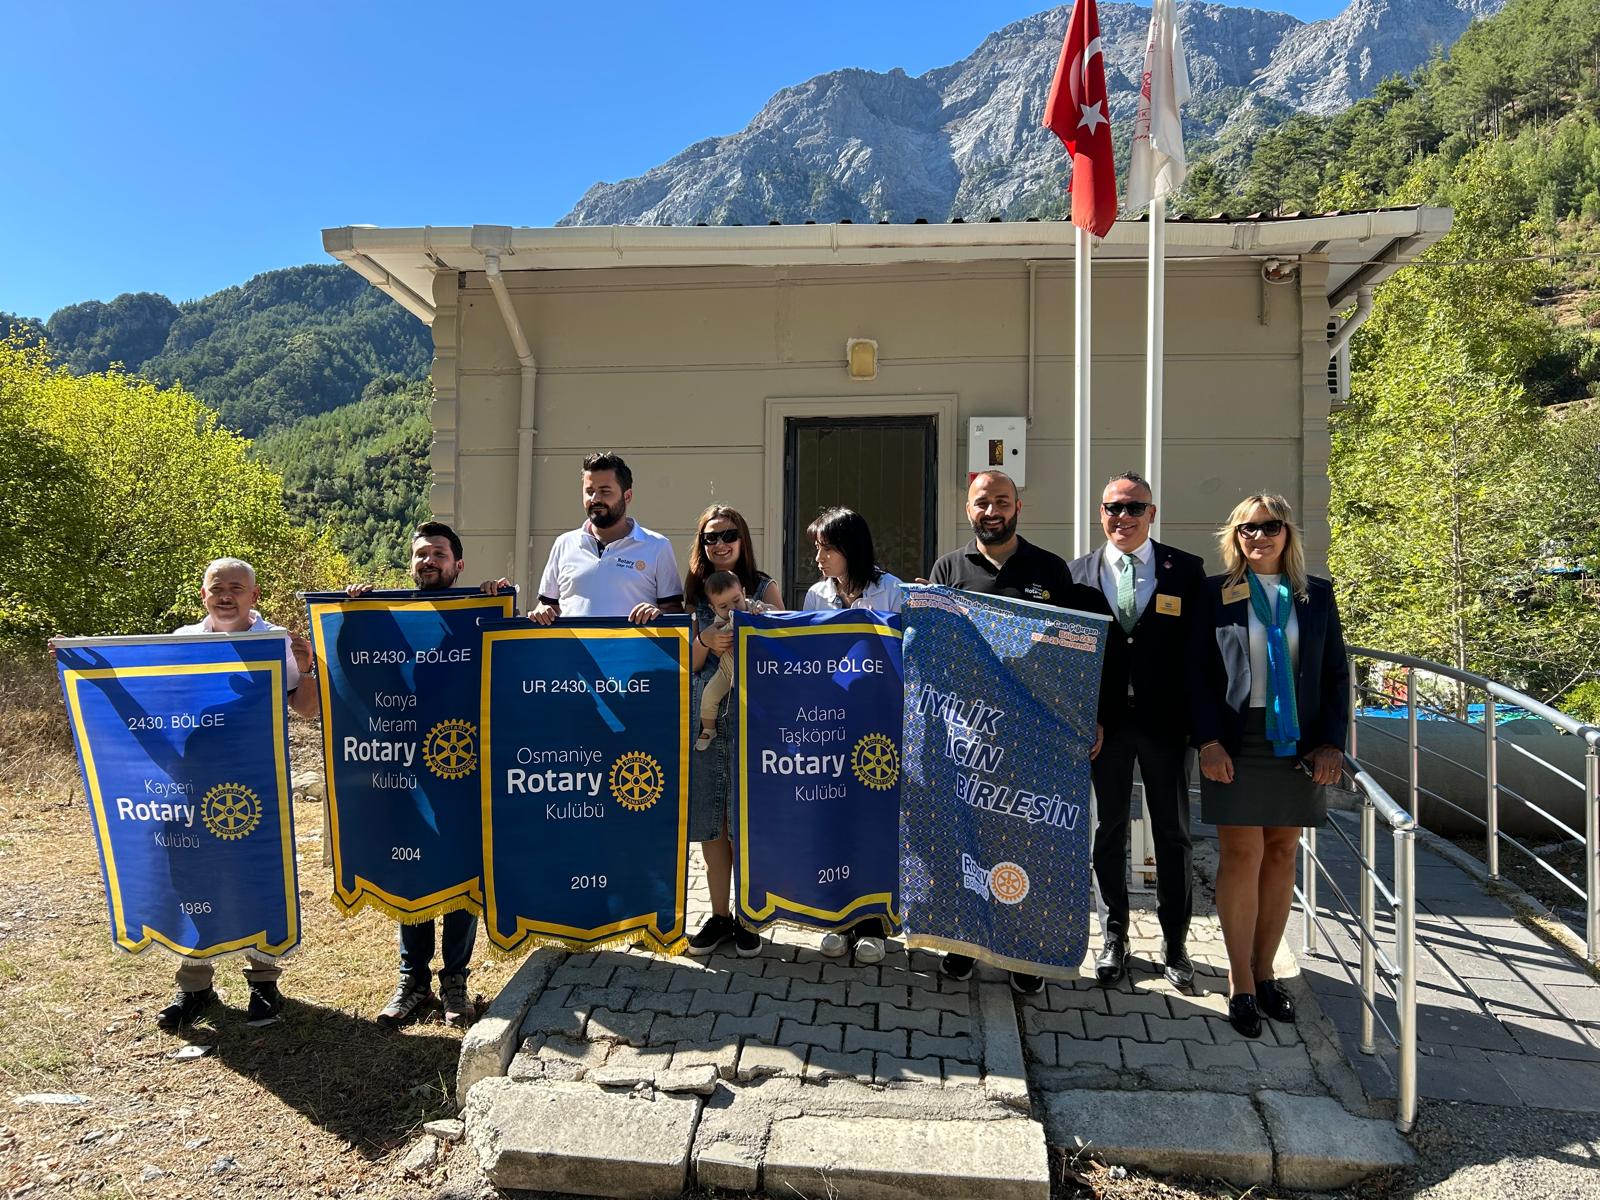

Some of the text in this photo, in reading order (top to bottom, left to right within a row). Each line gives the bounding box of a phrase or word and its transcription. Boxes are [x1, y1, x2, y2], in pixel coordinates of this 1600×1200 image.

[983, 604, 1014, 617] Camargo
[1054, 620, 1068, 630] Can
[1059, 630, 1079, 641] Bölge
[351, 648, 471, 665] UR 2430. BÖLGE
[757, 657, 884, 675] UR 2430 BÖLGE
[522, 677, 650, 694] UR 2430. BÖLGE
[375, 691, 417, 711] Konya
[917, 684, 1004, 735] İYİLİK
[128, 712, 225, 731] 2430. BÖLGE
[796, 706, 846, 722] Adana
[369, 717, 417, 732] Meram
[779, 727, 846, 748] Taşköprü
[343, 736, 417, 767] Rotary
[517, 746, 602, 766] Osmaniye
[946, 728, 1004, 773] İÇİN
[762, 750, 845, 778] Rotary
[144, 779, 194, 799] Kayseri
[372, 772, 417, 789] Kulübü
[507, 769, 603, 796] Rotary
[795, 784, 847, 801] Kulübü
[956, 773, 1079, 830] BİRLEŞİN
[117, 798, 195, 828] Rotary
[546, 802, 604, 820] Kulübü
[154, 831, 200, 849] Kulübü
[391, 847, 421, 861] 2004
[571, 876, 607, 889] 2019
[818, 865, 850, 884] 2019
[179, 901, 213, 915] 1986
